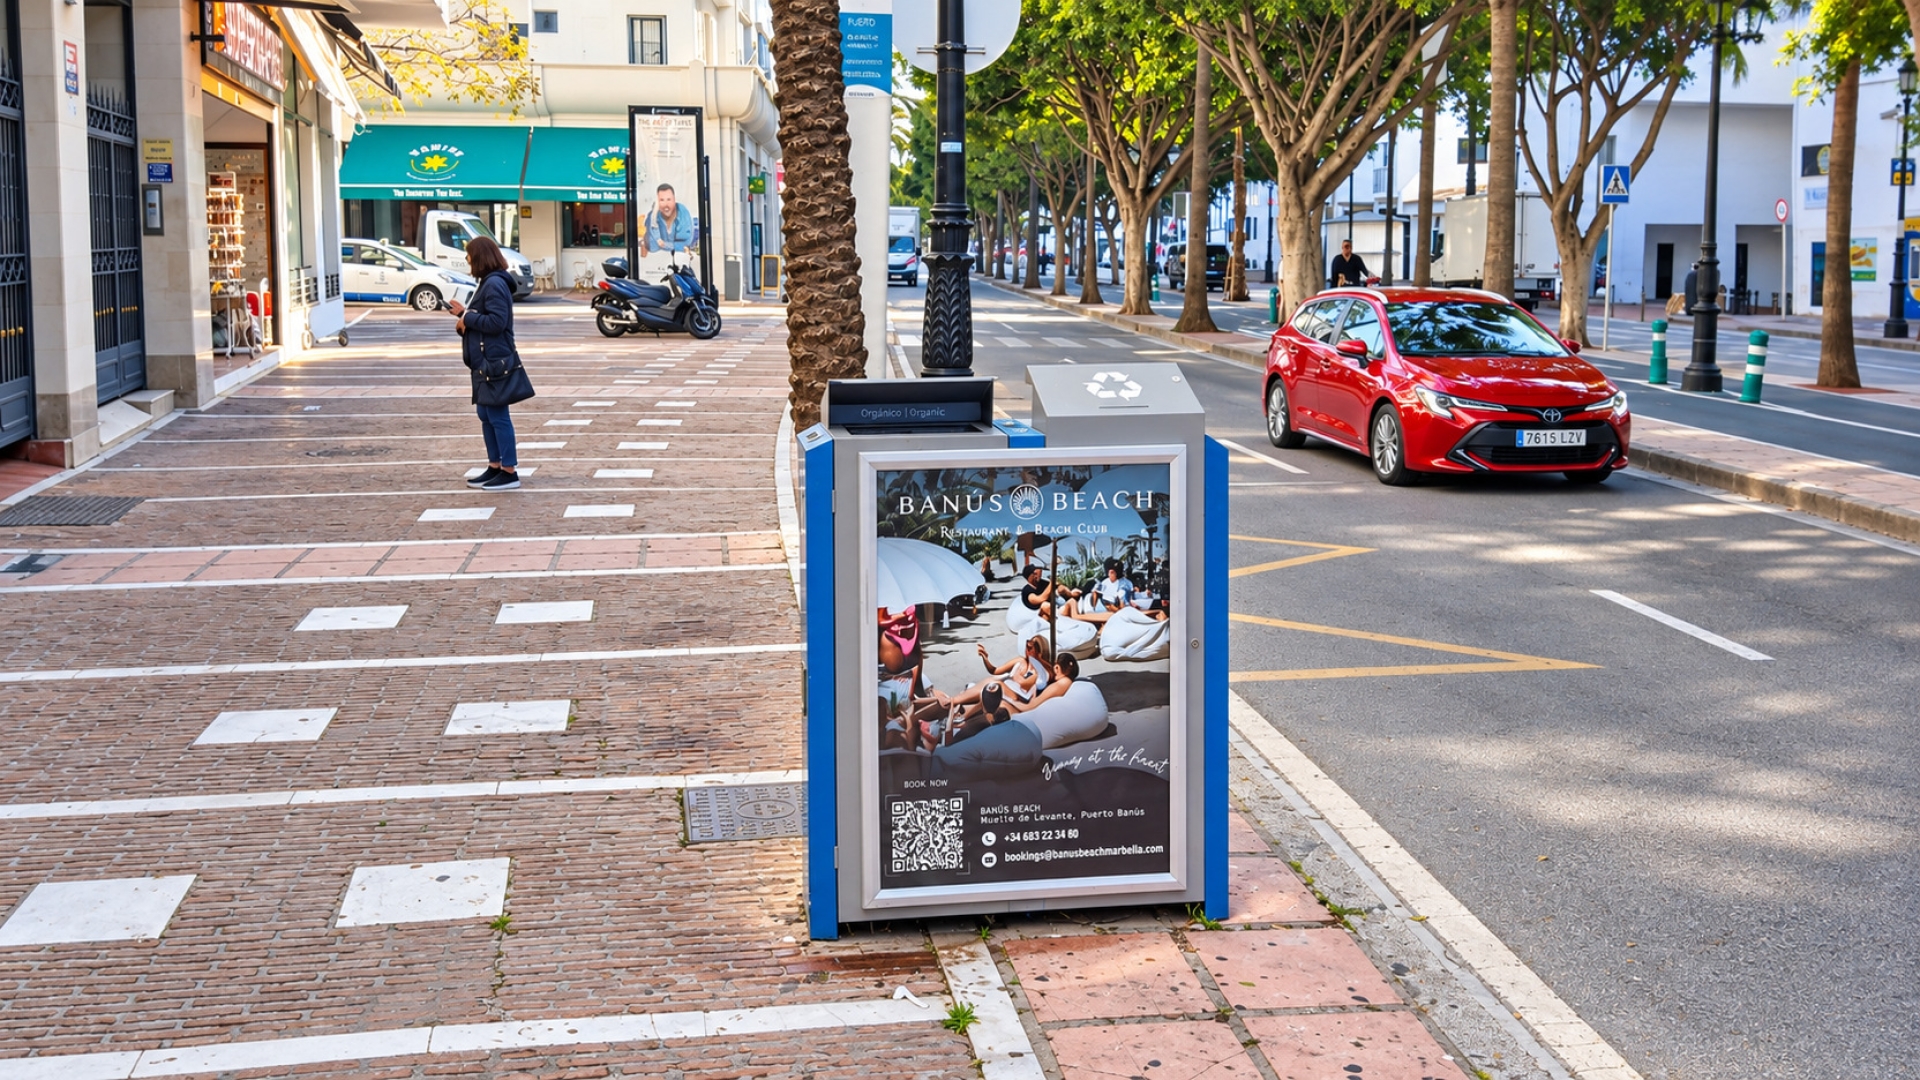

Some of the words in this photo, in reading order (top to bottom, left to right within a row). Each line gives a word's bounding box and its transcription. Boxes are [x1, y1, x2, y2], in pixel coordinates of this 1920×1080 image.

[861, 408, 902, 420] Orgánico
[909, 407, 945, 418] Organic
[1526, 432, 1557, 445] 7615
[899, 488, 1003, 516] BANÚS
[1053, 490, 1154, 512] BEACH
[904, 780, 926, 788] BOOK
[929, 779, 948, 787] NOW
[1012, 804, 1041, 813] BEACH
[1081, 810, 1114, 819] Puerto
[1117, 807, 1146, 818] Banús
[1004, 832, 1021, 842] +34
[1041, 830, 1053, 840] 22
[1054, 829, 1066, 839] 34
[1004, 844, 1164, 863] bookings@banusbeachmarbella.com
